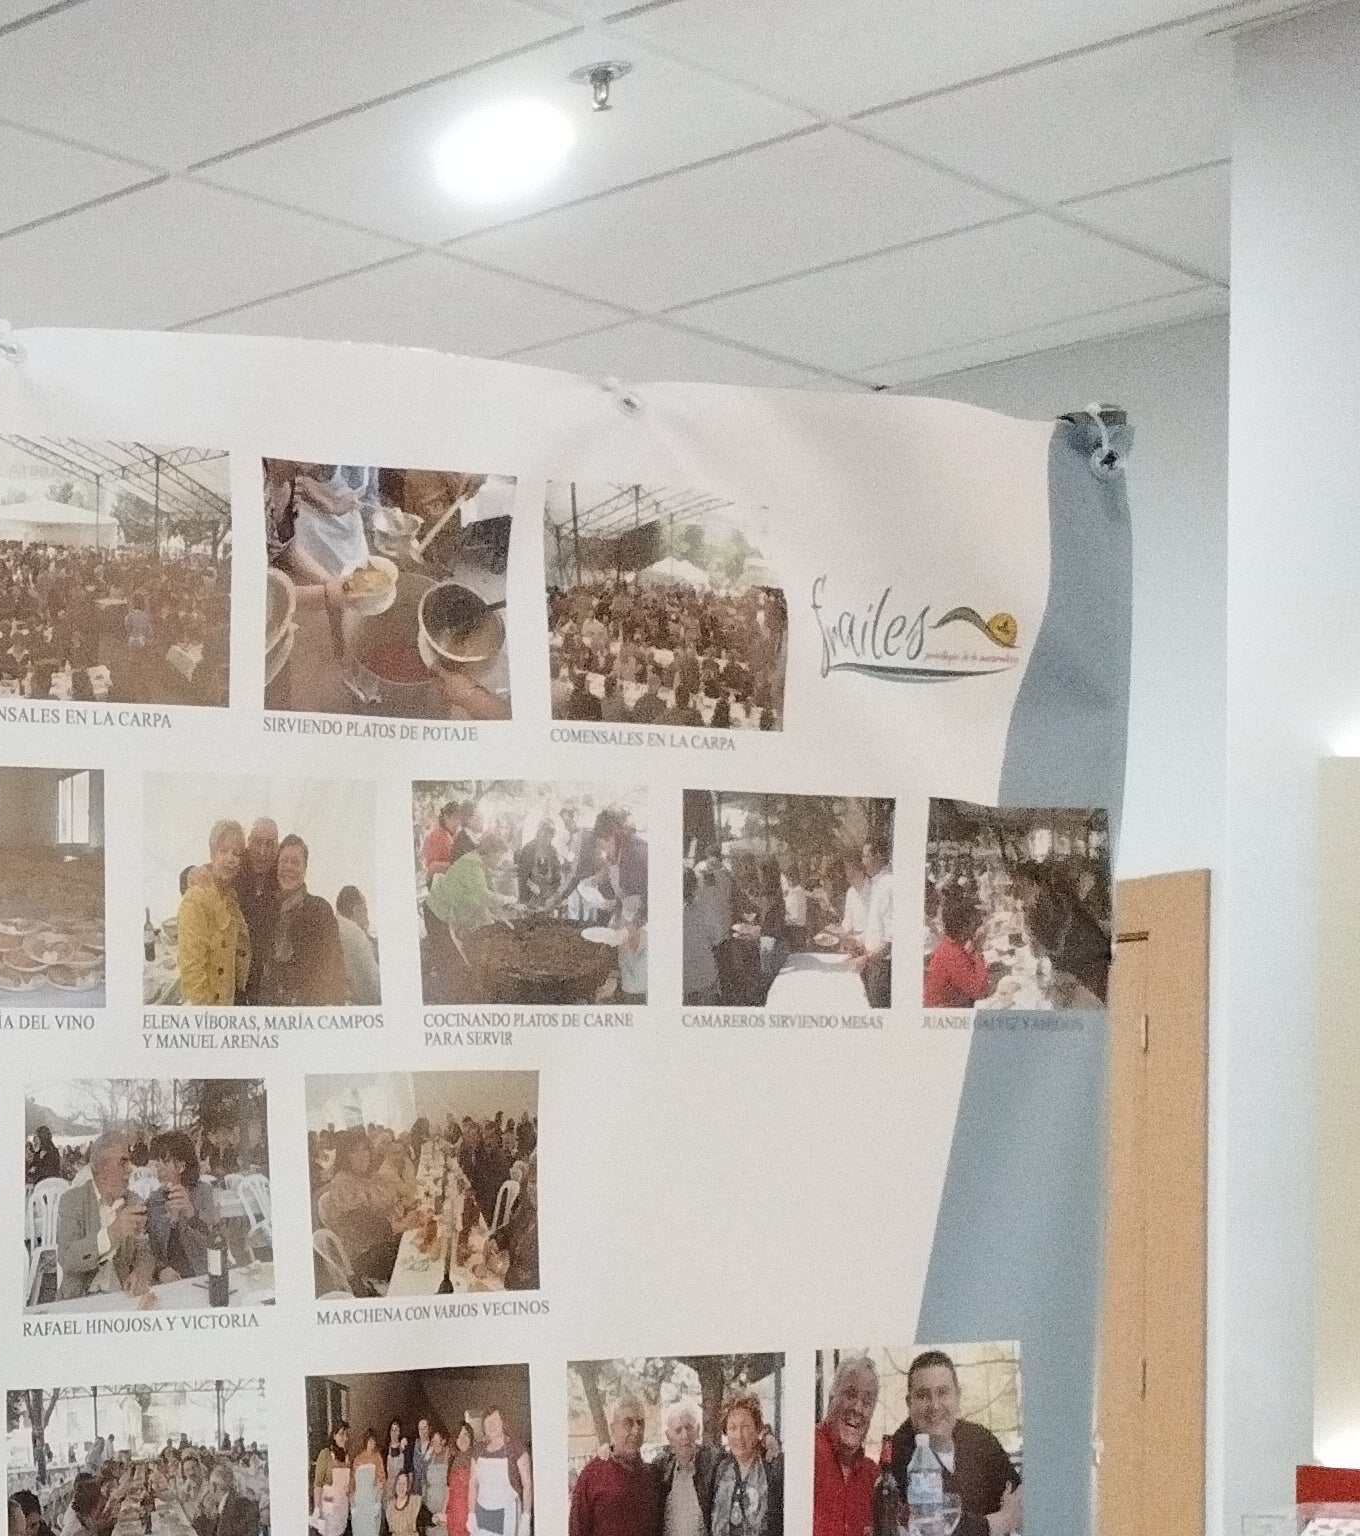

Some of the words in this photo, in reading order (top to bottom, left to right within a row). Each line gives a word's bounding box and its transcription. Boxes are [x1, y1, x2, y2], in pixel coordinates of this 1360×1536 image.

[550, 728, 643, 745] COMENSALES
[648, 733, 664, 747] EN
[670, 735, 688, 748] LA
[691, 735, 735, 751] CARPA
[19, 1015, 49, 1029] DEL
[54, 1015, 94, 1029] VINO
[423, 1013, 510, 1027] COCINANDO
[513, 1013, 558, 1027] PLATOS
[562, 1013, 580, 1026] DE
[584, 1013, 633, 1027] CARNE
[22, 1321, 81, 1336] RAFAEL
[87, 1318, 162, 1334] HINOJOSA
[167, 1317, 178, 1330] Y
[180, 1313, 259, 1330] VICTORIA
